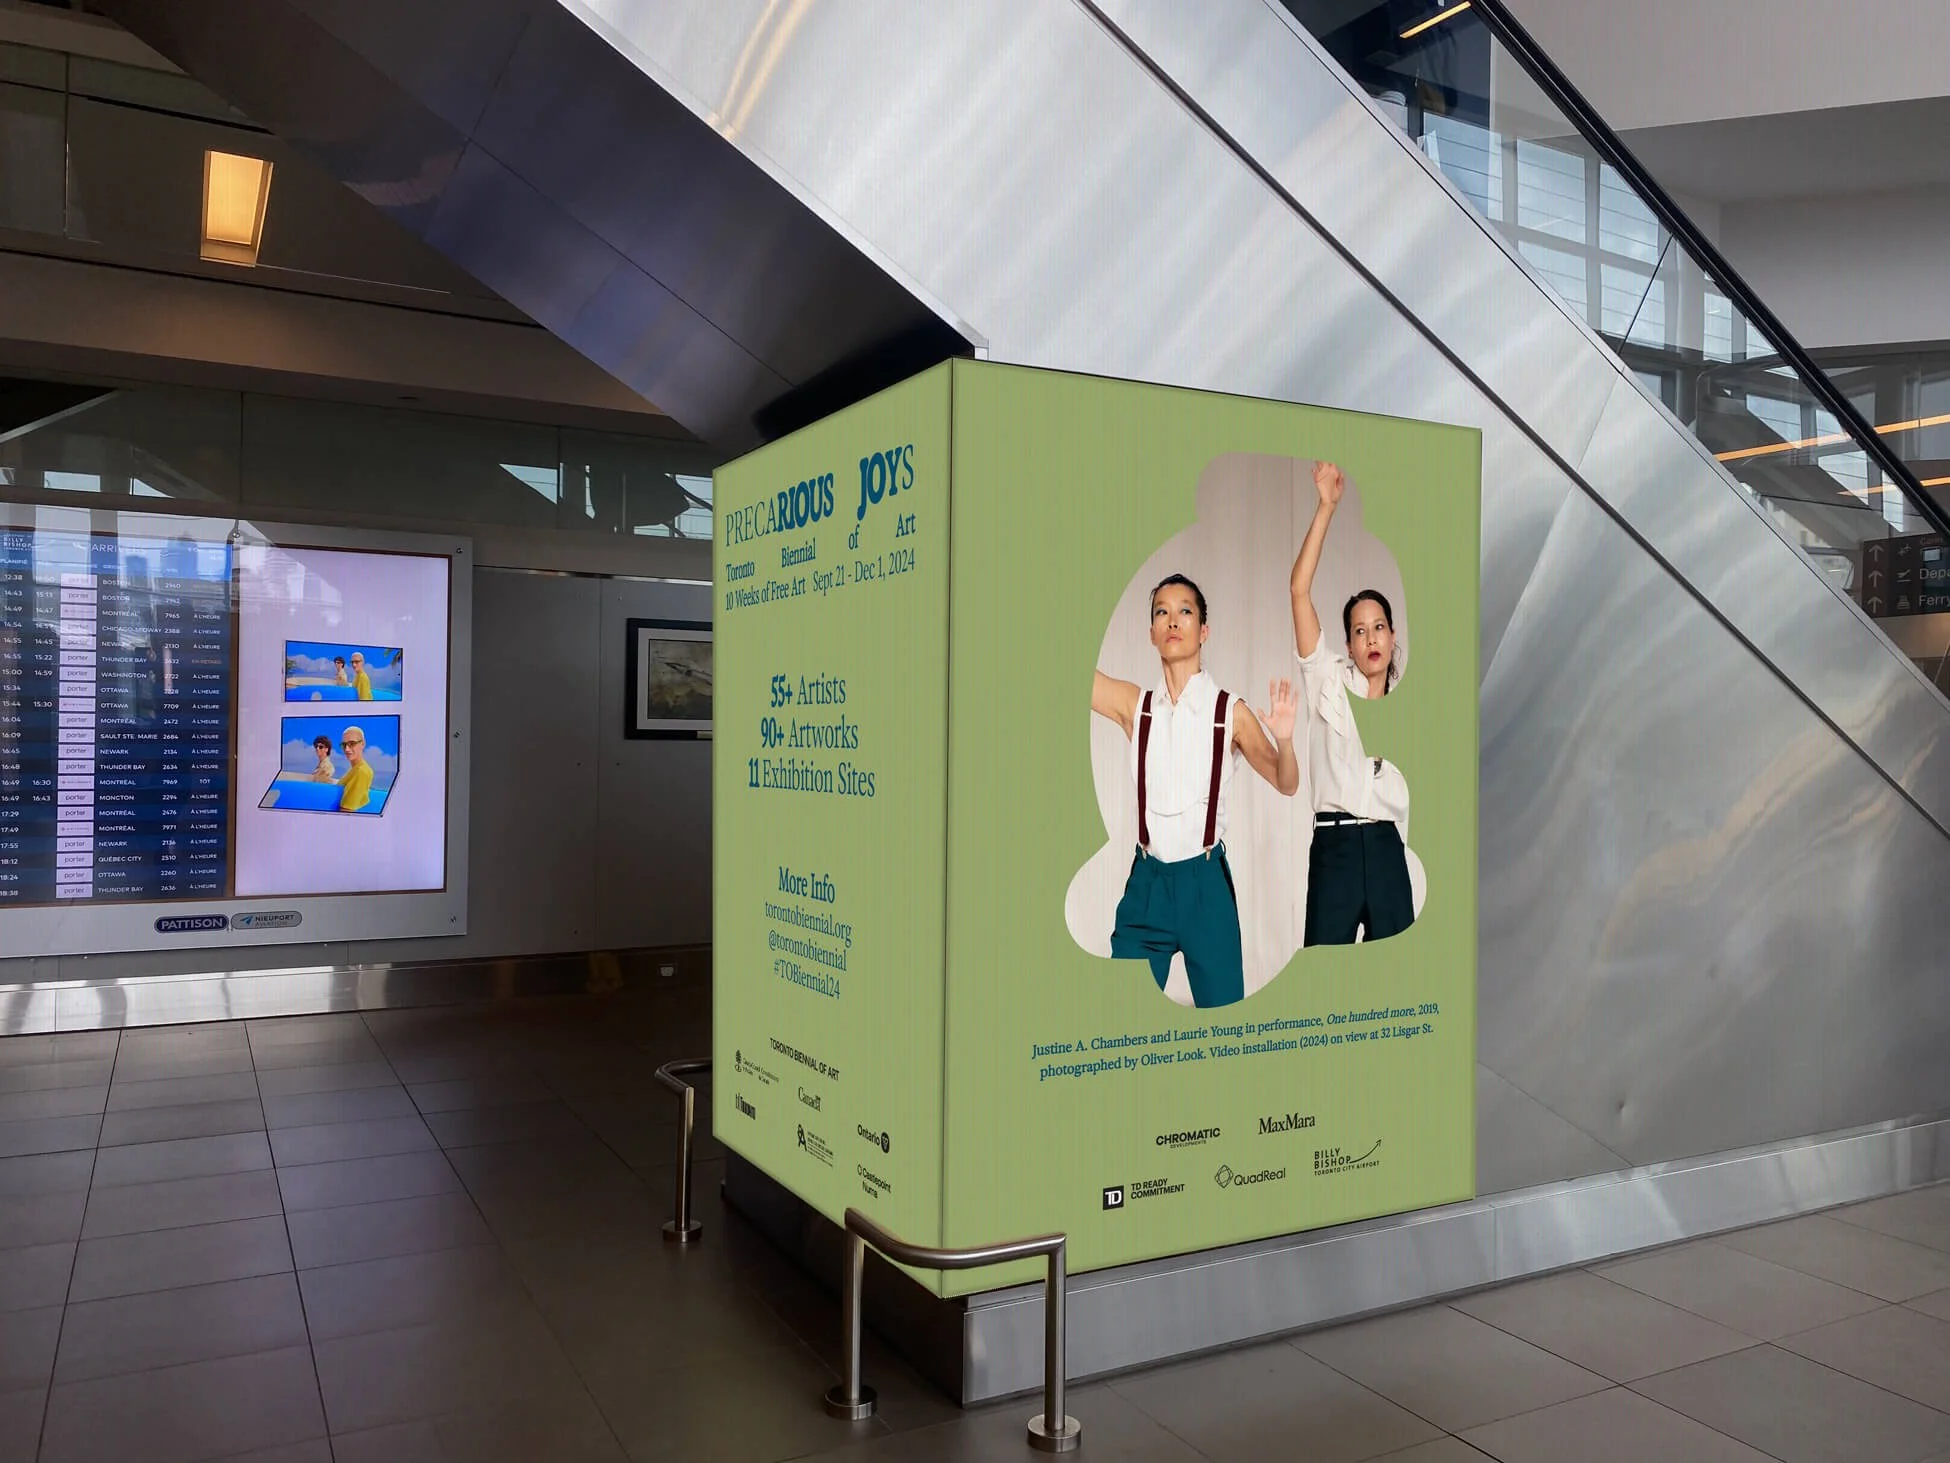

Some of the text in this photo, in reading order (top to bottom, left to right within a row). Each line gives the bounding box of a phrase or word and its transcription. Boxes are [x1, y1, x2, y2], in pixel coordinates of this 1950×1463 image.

[726, 444, 914, 547] PRECARIOUS JOYS
[726, 512, 916, 582] Toronto Biennial of Art
[725, 591, 734, 611] 10
[735, 584, 760, 609] Weeks
[761, 582, 771, 604] of
[772, 580, 789, 601] Free
[790, 576, 806, 598] Art
[812, 570, 833, 596] Sept
[835, 566, 846, 586] 21
[854, 560, 876, 583] Dec
[877, 556, 886, 582] 1,
[888, 548, 915, 576] 2024
[770, 672, 846, 708] 55+ Artists
[760, 713, 858, 750] 90+ Artworks
[748, 758, 876, 798] 11 Exhibition Sites
[778, 866, 836, 904] More Info
[162, 918, 223, 930] PATTISON
[765, 900, 852, 948] torontobiennial.org
[768, 929, 847, 972] @torontobiennial
[774, 958, 840, 1000] #TOBiennial24
[1032, 1003, 1440, 1060] Justine A. Chambers and Laurie Young in performance, One hundred more, 2019,
[770, 1037, 794, 1058] TORONTO
[794, 1049, 818, 1072] BIENNIAL
[818, 1062, 828, 1075] OF
[828, 1066, 840, 1082] ART
[1040, 1023, 1434, 1082] photographed by Oliver Look. Video installation (2024) on view at 32 Lisgar St.
[857, 1124, 880, 1146] Ontario
[1156, 1112, 1316, 1146] CHROMATIC MaxMara
[1314, 1148, 1341, 1160] BILLY
[1314, 1155, 1351, 1170] BISHOP
[1314, 1160, 1380, 1176] TORONTO CITY AIRPORT
[1130, 1178, 1168, 1192] TD READY
[1130, 1184, 1185, 1200] COMMITMENT
[1234, 1168, 1286, 1186] QuadReal
[1104, 1189, 1122, 1206] TD
